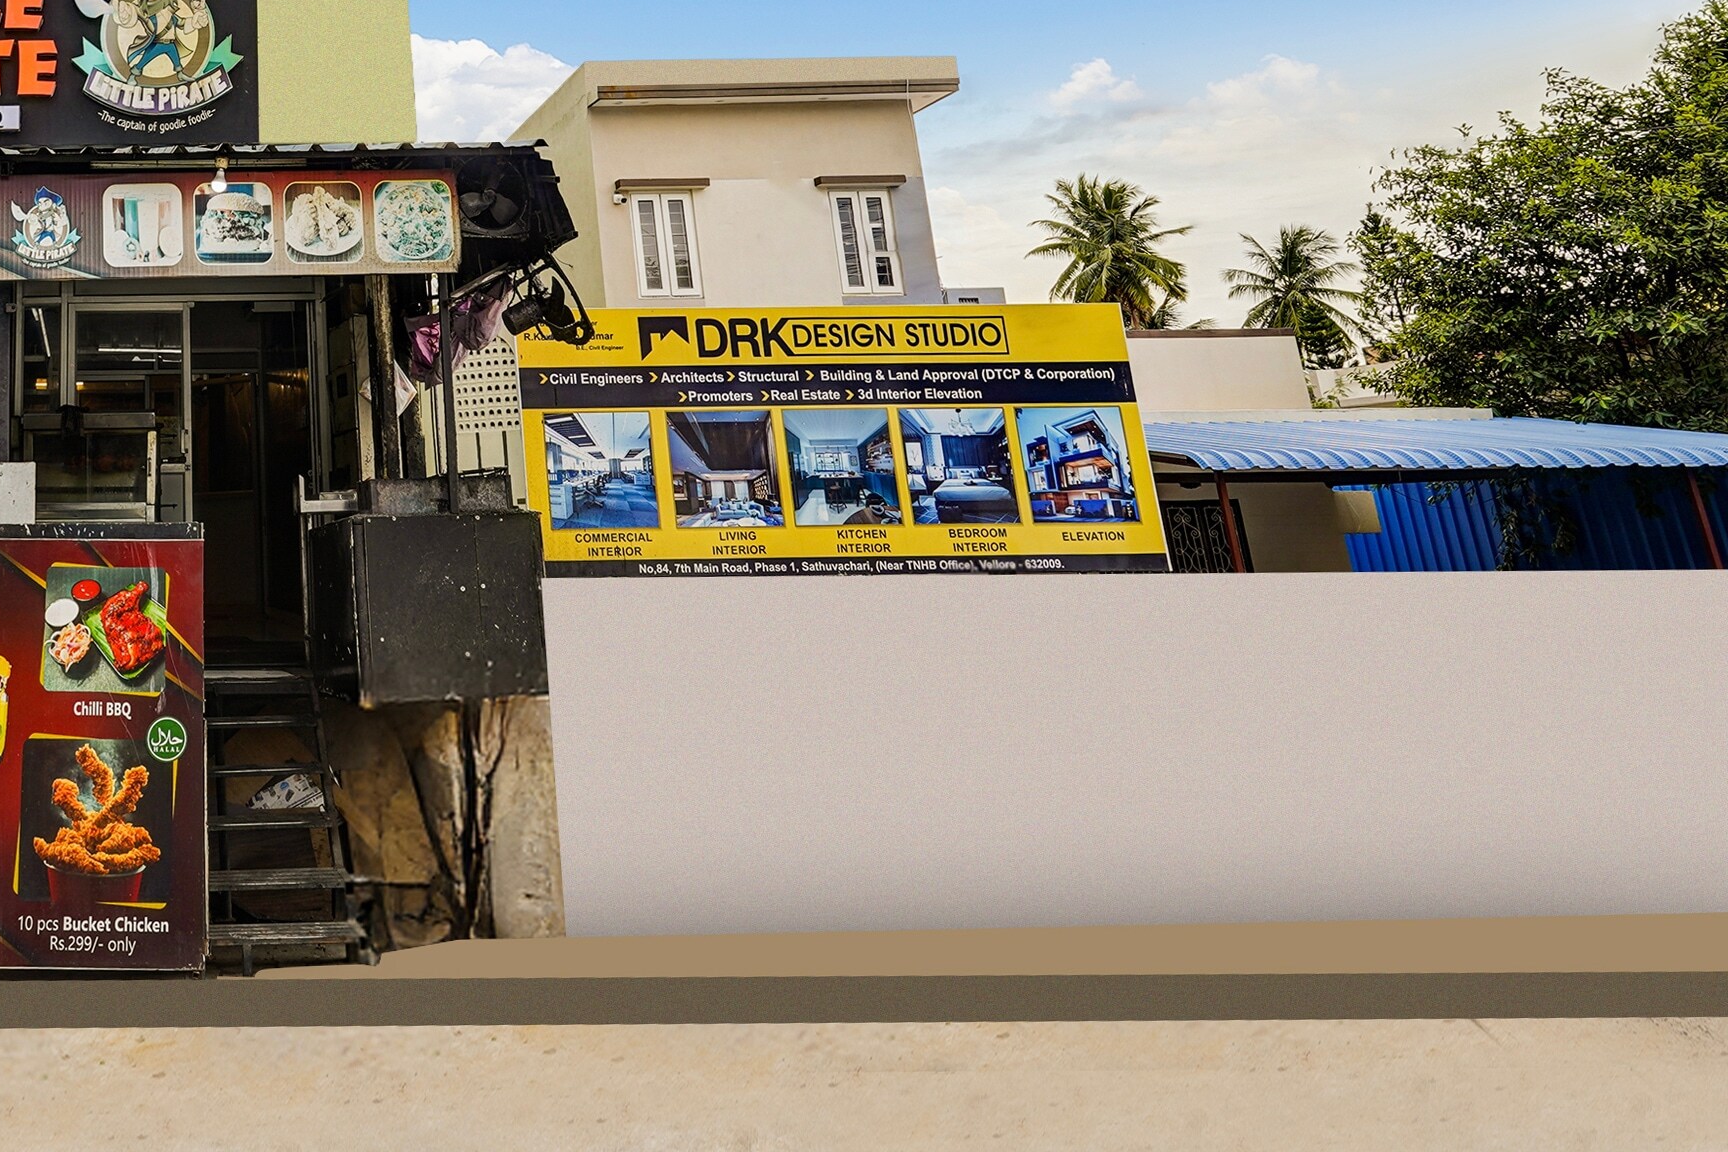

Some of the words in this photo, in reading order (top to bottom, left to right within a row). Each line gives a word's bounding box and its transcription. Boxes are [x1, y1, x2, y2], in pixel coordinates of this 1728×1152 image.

[116, 119, 146, 132] captain
[148, 121, 157, 134] of
[159, 118, 187, 135] goodie
[695, 318, 794, 358] DRK
[792, 323, 895, 348] DESIGN
[904, 322, 1002, 347] STUDIO
[601, 344, 624, 352] Engineer
[549, 373, 577, 385] Civil
[580, 372, 643, 387] Engineers
[661, 371, 724, 384] Architects
[738, 370, 800, 382] Structural
[821, 370, 872, 384] Building
[875, 370, 885, 381] &
[888, 369, 920, 381] Land
[922, 368, 978, 384] Approval
[981, 368, 1021, 382] (DTCP
[1024, 368, 1034, 379] &
[1037, 367, 1115, 383] Corporation)
[688, 390, 754, 402] Promoters
[770, 389, 798, 401] Real
[801, 389, 840, 400] Estate
[858, 388, 873, 400] 3d
[876, 388, 921, 400] Interior
[924, 388, 983, 399] Elevation
[575, 533, 653, 543] COMMERCIAL
[719, 531, 757, 541] LIVING
[836, 529, 887, 539] KITCHEN
[948, 528, 1007, 538] BEDROOM
[1062, 531, 1125, 542] ELEVATION
[587, 546, 642, 557] INTERIOR
[712, 545, 767, 555] INTERIOR
[836, 543, 891, 553] INTERIOR
[953, 542, 1008, 552] INTERIOR
[639, 563, 672, 575] No,84,
[674, 563, 692, 574] 7th
[694, 563, 719, 574] Main
[722, 563, 752, 575] Road,
[755, 563, 787, 573] Phase
[790, 561, 799, 573] 1,
[802, 560, 873, 573] Sathuvachari,
[876, 560, 904, 573] (Near
[905, 560, 937, 570] TNHB
[1025, 559, 1065, 569] 632009.
[74, 701, 103, 716] Chilli
[106, 702, 132, 720] BBQ
[151, 727, 183, 747] حلال
[18, 915, 33, 931] 10
[37, 919, 59, 935] pcs
[63, 916, 111, 932] Bucket
[114, 916, 169, 933] Chicken
[50, 936, 103, 954] Rs.299/-
[108, 936, 136, 956] only
